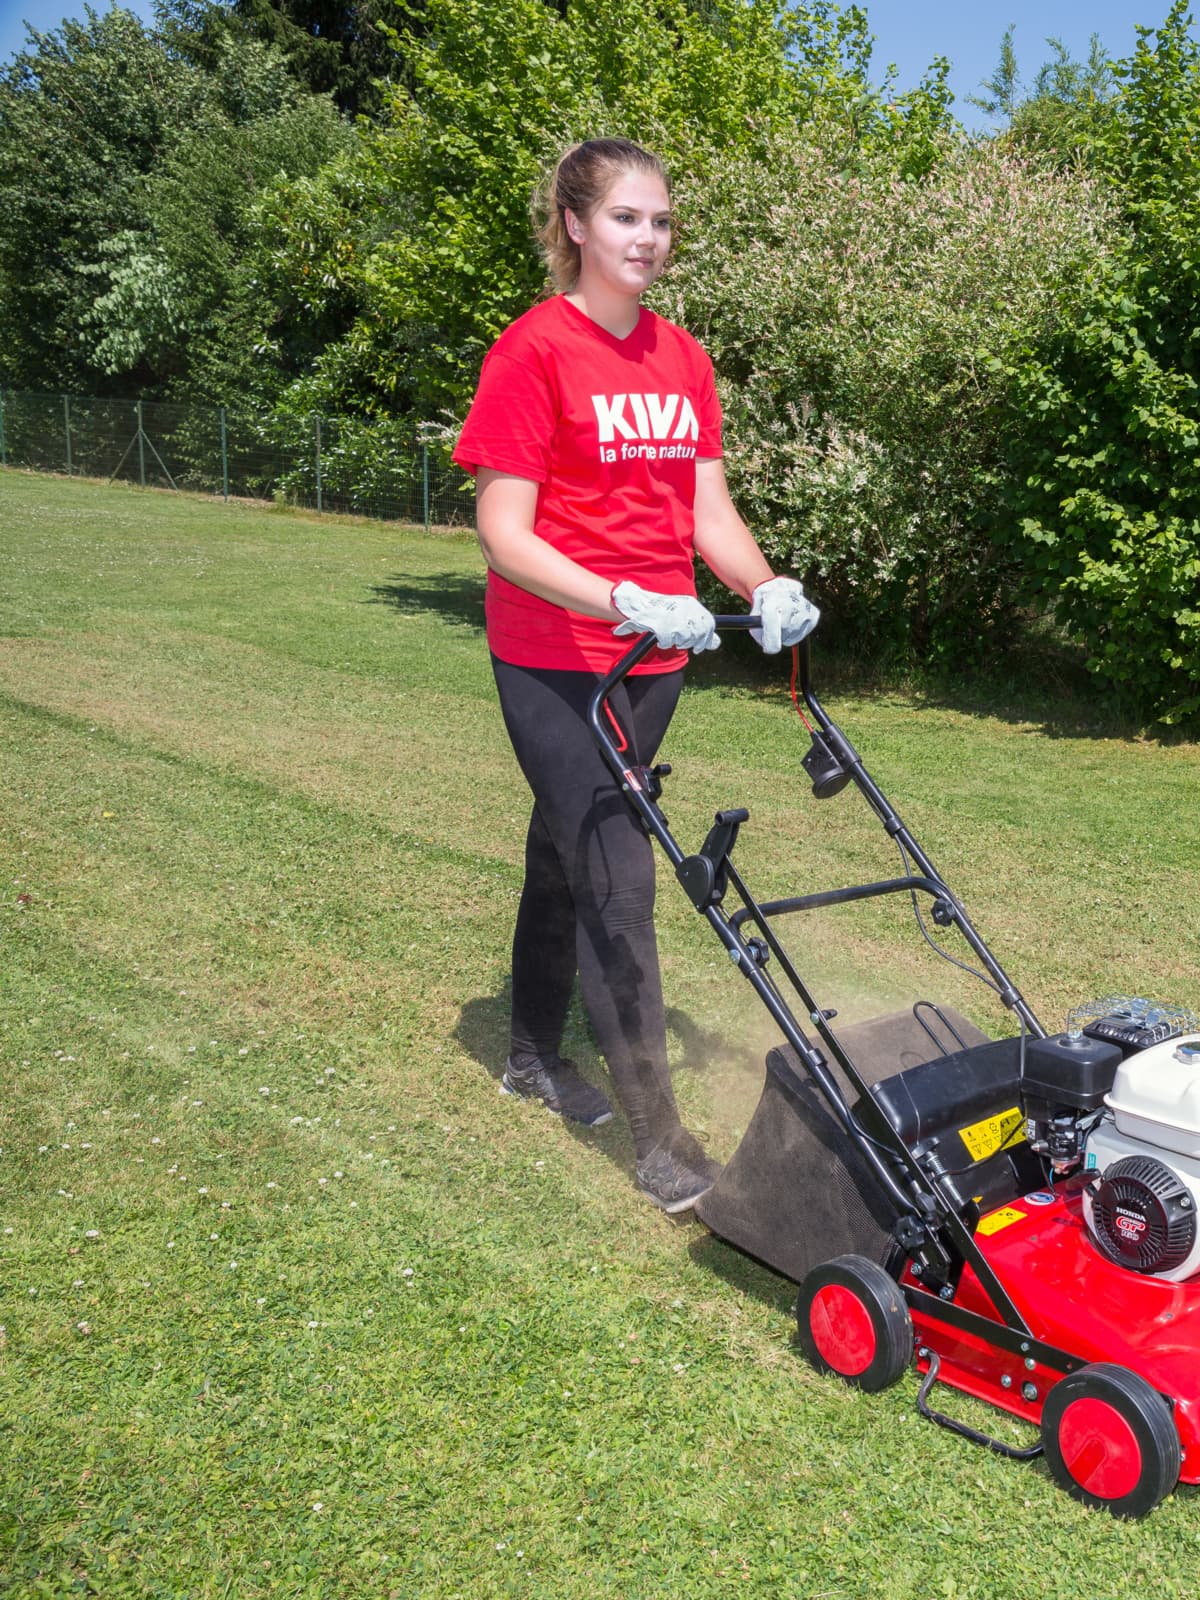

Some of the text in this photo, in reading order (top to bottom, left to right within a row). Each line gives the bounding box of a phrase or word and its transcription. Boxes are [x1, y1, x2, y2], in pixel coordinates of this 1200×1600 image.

[591, 393, 699, 442] KIVA
[599, 445, 617, 463] la
[1115, 1206, 1147, 1222] HONDA
[1116, 1215, 1146, 1233] GP
